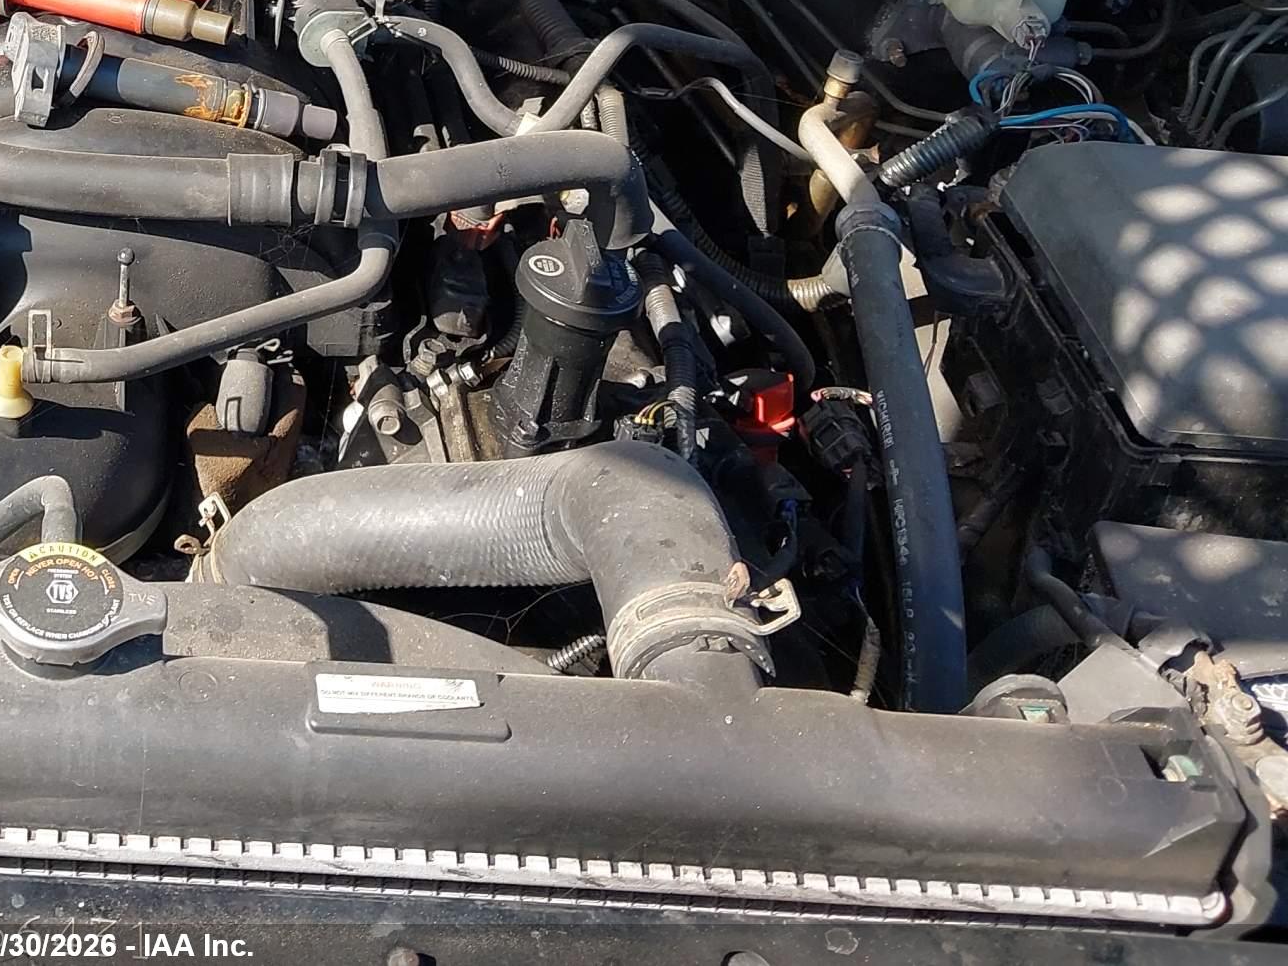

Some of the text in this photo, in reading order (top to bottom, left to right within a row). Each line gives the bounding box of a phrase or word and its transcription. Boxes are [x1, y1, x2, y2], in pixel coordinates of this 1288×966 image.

[38, 544, 99, 562] CAUTION
[8, 568, 20, 584] OPEN
[25, 557, 99, 582] NEVER OPEN HOT
[52, 584, 73, 600] TVS
[2, 593, 13, 609] TEST
[8, 608, 19, 619] OR
[14, 617, 45, 637] REPLACE
[45, 631, 68, 640] WHEN
